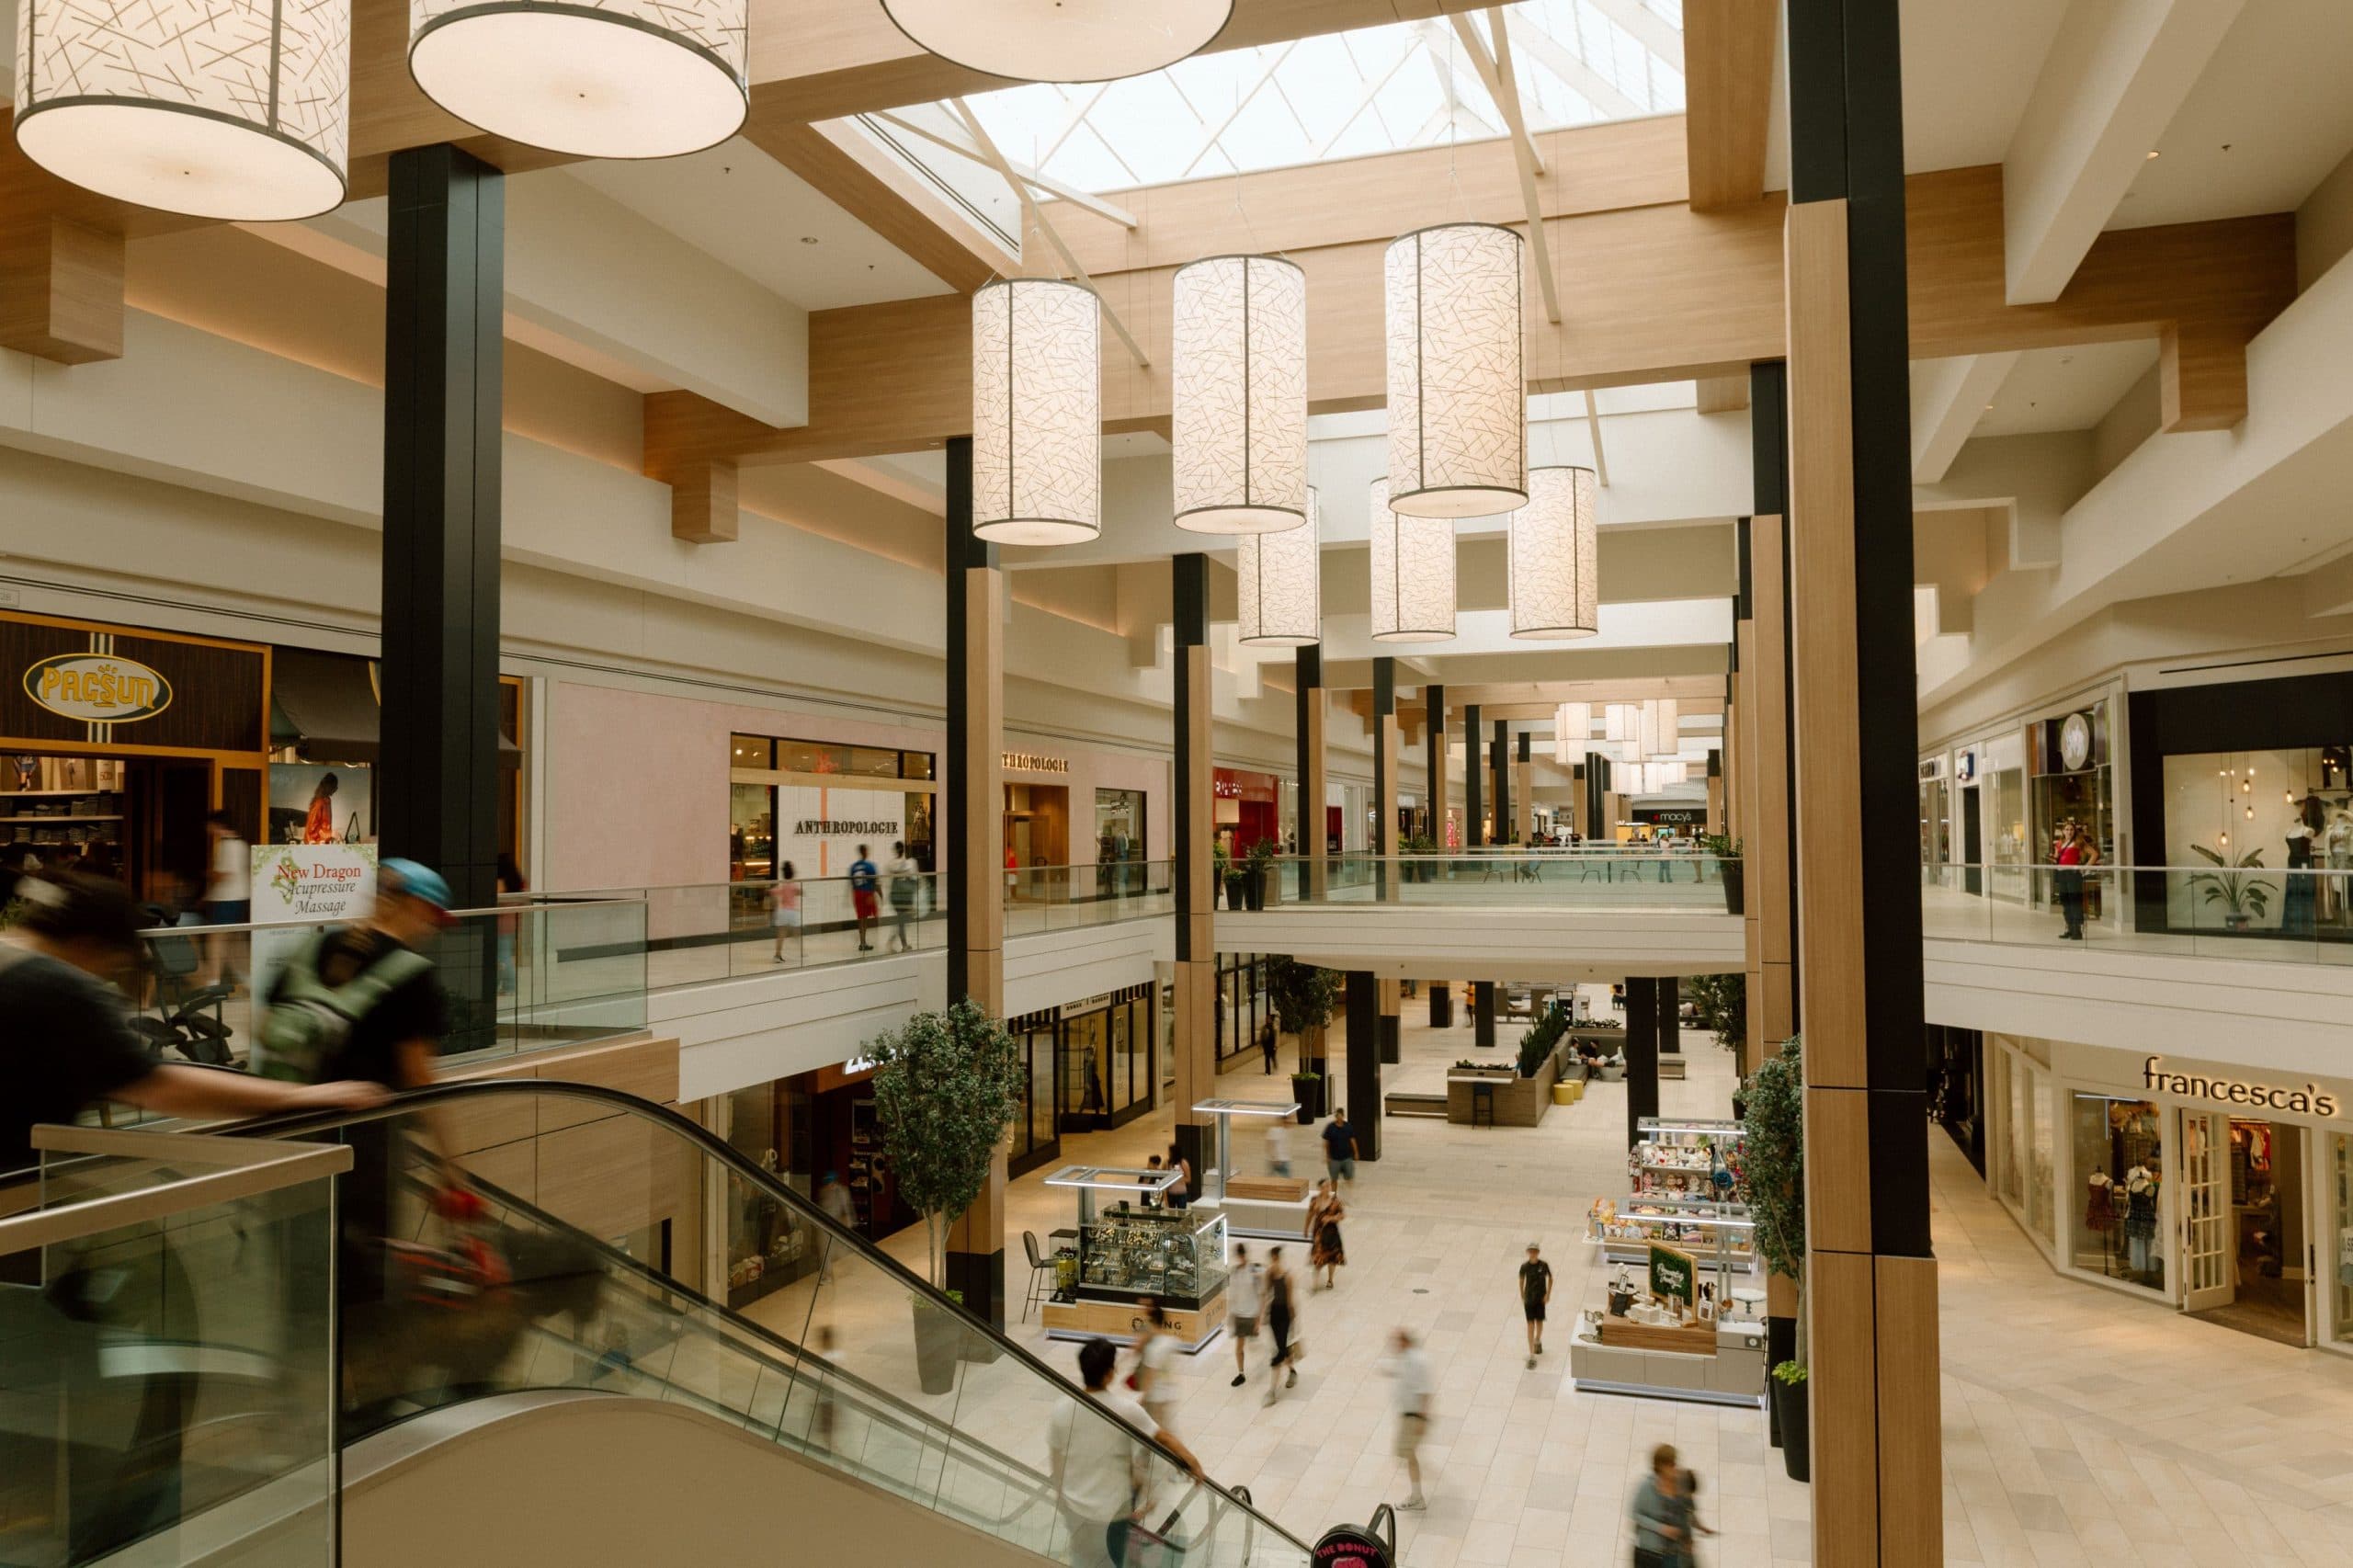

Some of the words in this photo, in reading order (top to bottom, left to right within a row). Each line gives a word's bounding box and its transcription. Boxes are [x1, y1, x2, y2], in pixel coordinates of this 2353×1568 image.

[1002, 754, 1069, 773] THROPOLOGIE
[794, 820, 898, 835] ANTHROPOLOGIE
[278, 865, 309, 880] New
[313, 864, 361, 881] Dragon
[283, 882, 356, 899] Acupressure
[295, 901, 347, 915] Massage
[2143, 1056, 2336, 1117] francesca's
[1316, 1544, 1336, 1559] THE
[1337, 1542, 1377, 1557] DONUT
